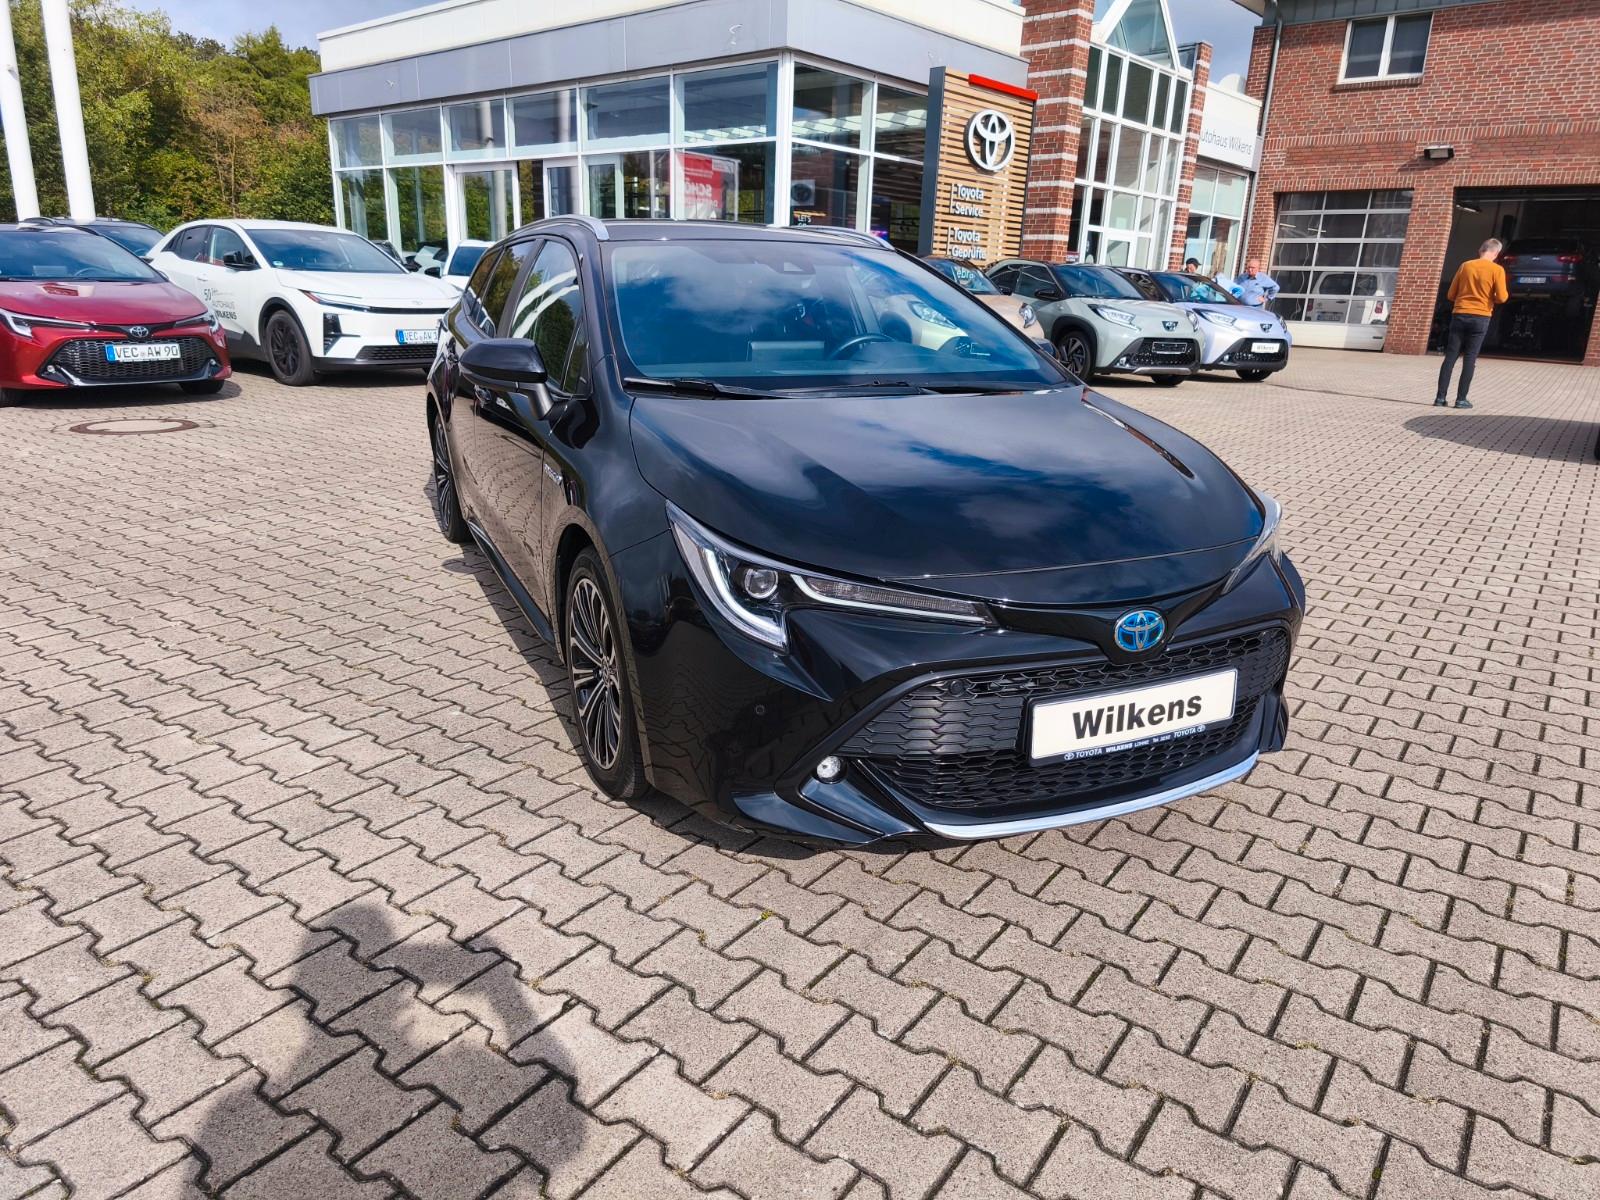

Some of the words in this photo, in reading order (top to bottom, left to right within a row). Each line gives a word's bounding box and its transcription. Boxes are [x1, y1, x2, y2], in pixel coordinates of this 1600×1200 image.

[1200, 129, 1228, 148] utohaus
[1229, 136, 1252, 155] Wilkens
[957, 183, 984, 200] Toyota
[955, 202, 984, 217] Service
[953, 227, 981, 243] Toyota
[951, 245, 987, 259] Geprüfte
[404, 331, 418, 341] VEC
[115, 347, 139, 358] VEC
[147, 346, 161, 357] AW
[164, 345, 178, 357] 90
[1072, 695, 1202, 740] Wilkens
[1075, 748, 1103, 759] TOYOTA
[1105, 742, 1133, 753] WILKENS
[1174, 728, 1197, 739] TOYOTA
